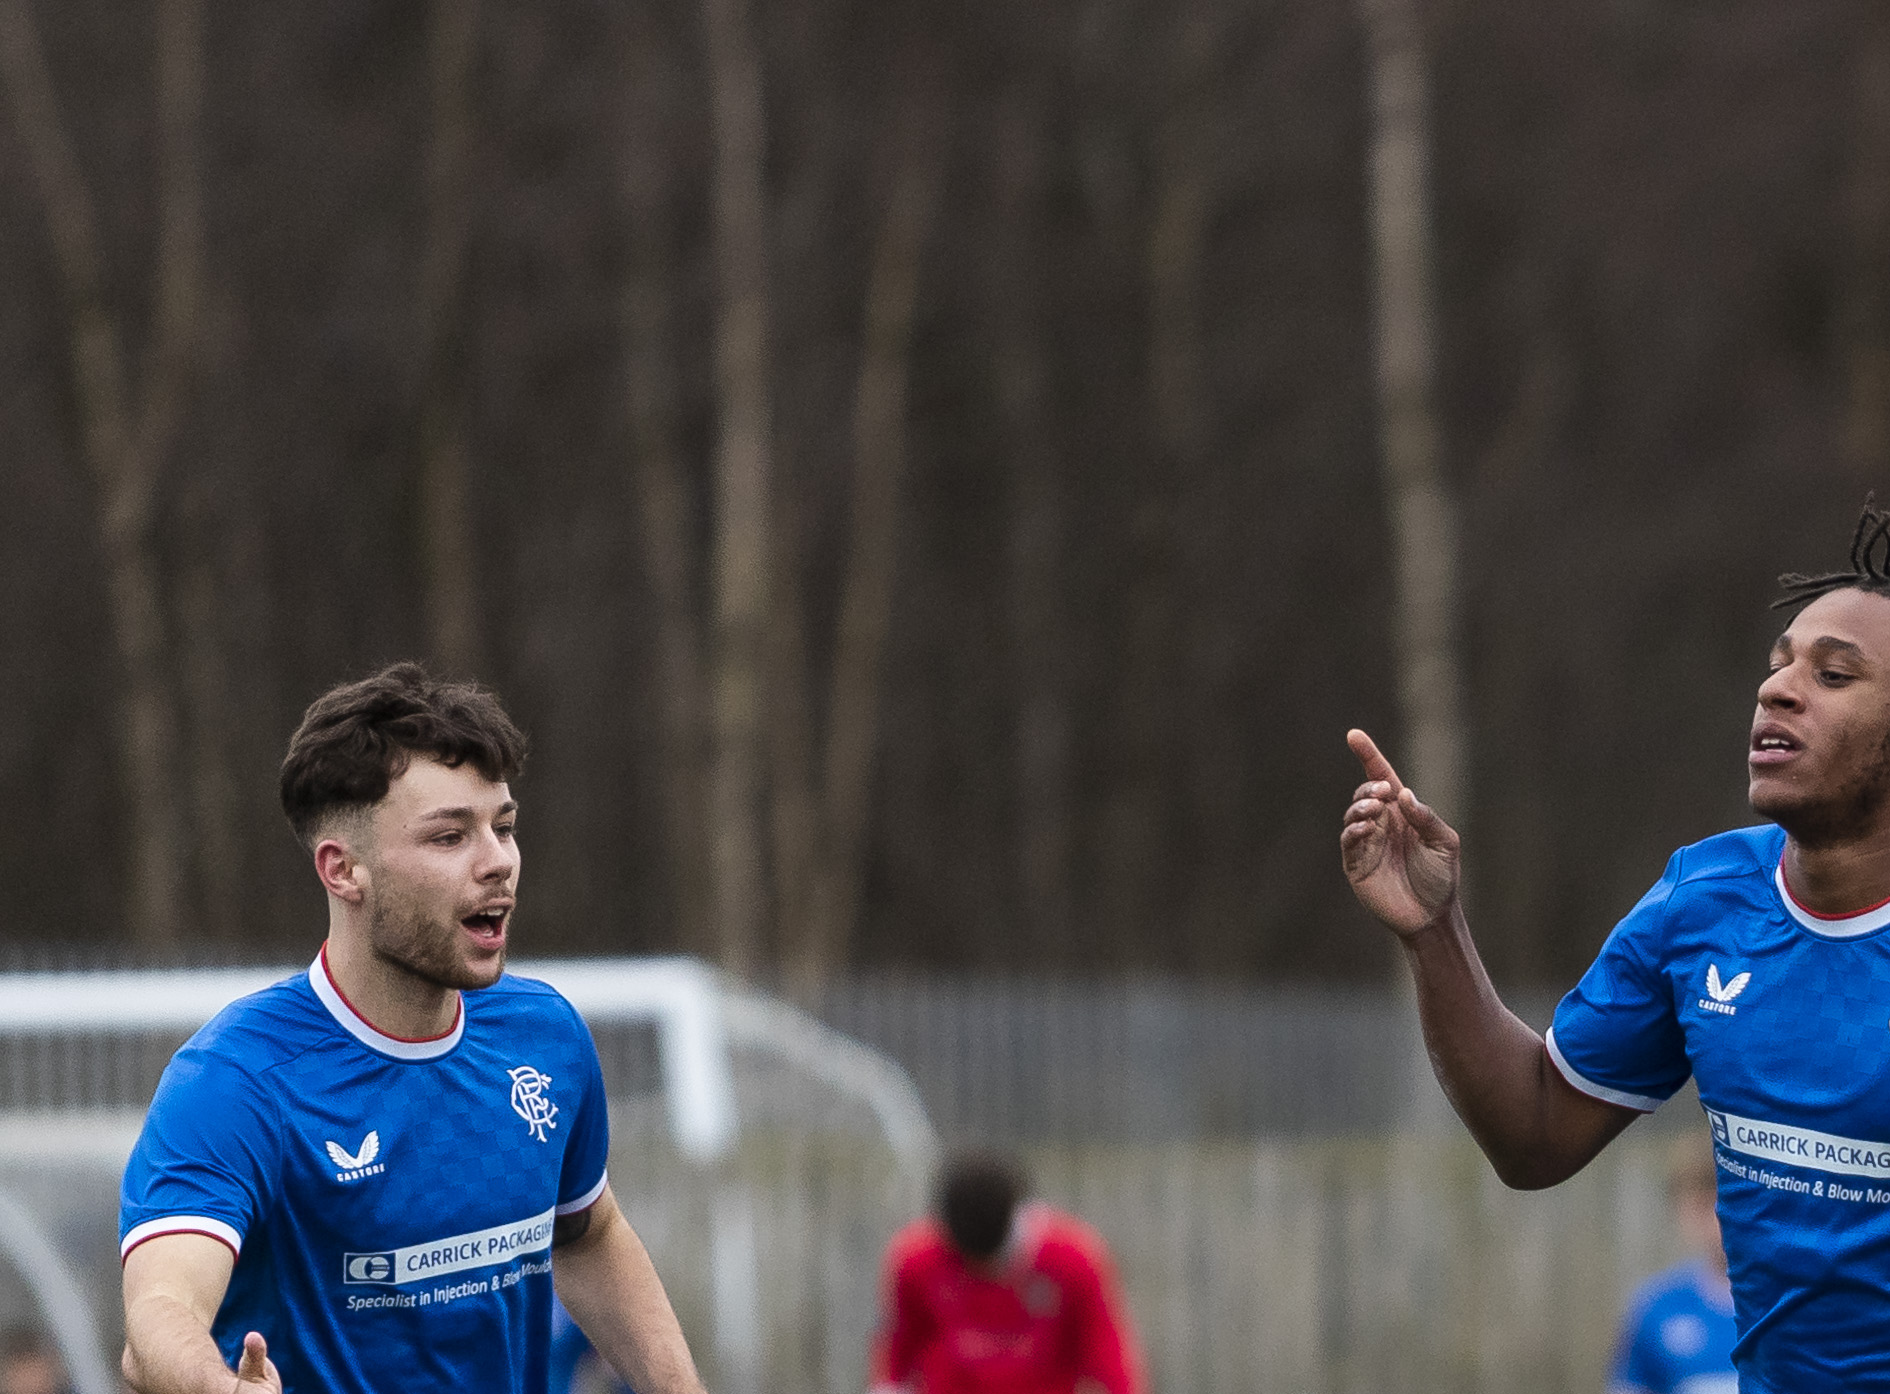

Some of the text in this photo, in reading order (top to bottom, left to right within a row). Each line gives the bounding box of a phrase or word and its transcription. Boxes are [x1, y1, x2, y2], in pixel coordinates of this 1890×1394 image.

[1698, 999, 1737, 1016] CASTORE
[1736, 1126, 1808, 1156] CARRICK
[1748, 1166, 1758, 1182] in
[1759, 1168, 1810, 1193] Injection
[1812, 1181, 1824, 1197] &
[1828, 1184, 1863, 1202] Blow
[407, 1240, 482, 1271] CARRICK
[347, 1294, 416, 1312] Specialist
[419, 1291, 431, 1306] in
[434, 1280, 488, 1304] Injection
[491, 1275, 500, 1291] &
